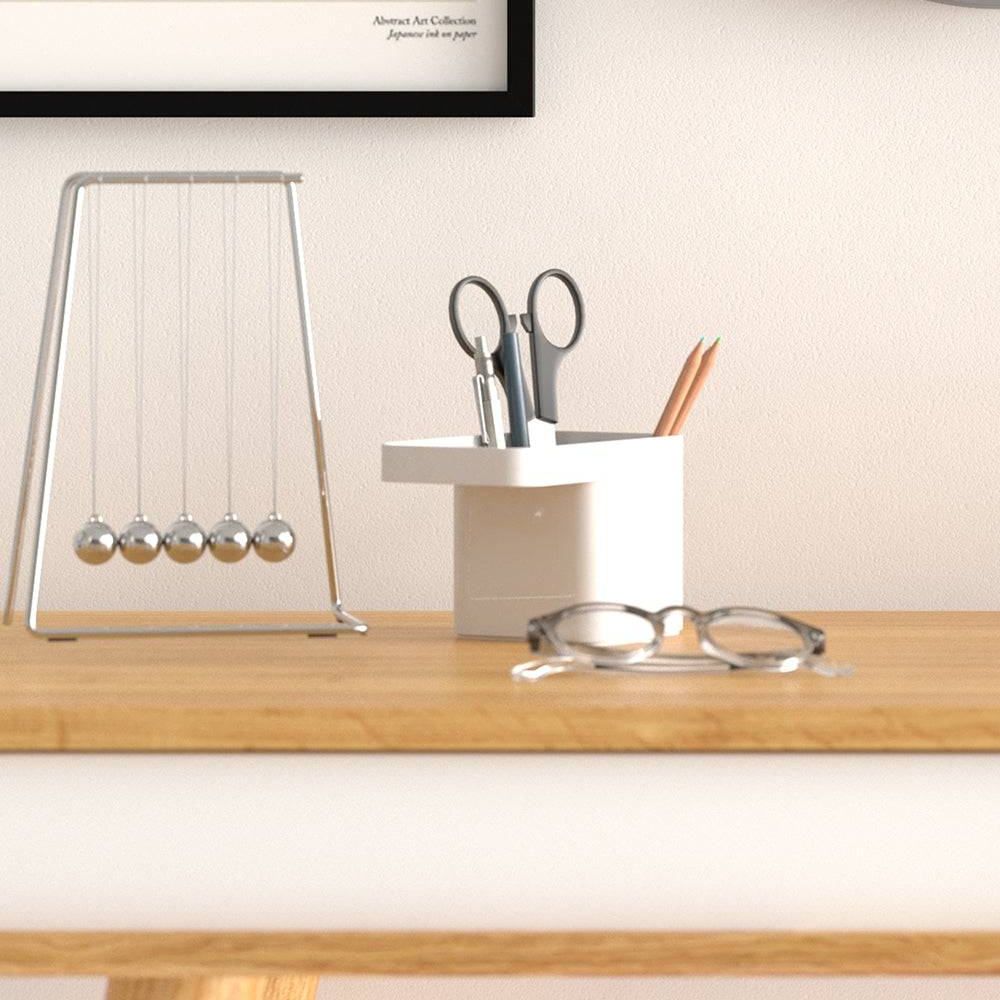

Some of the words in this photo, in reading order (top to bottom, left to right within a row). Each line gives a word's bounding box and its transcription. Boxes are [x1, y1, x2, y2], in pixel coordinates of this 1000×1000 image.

[373, 15, 410, 26] Abstract
[412, 15, 428, 26] Art
[430, 15, 477, 26] Collection
